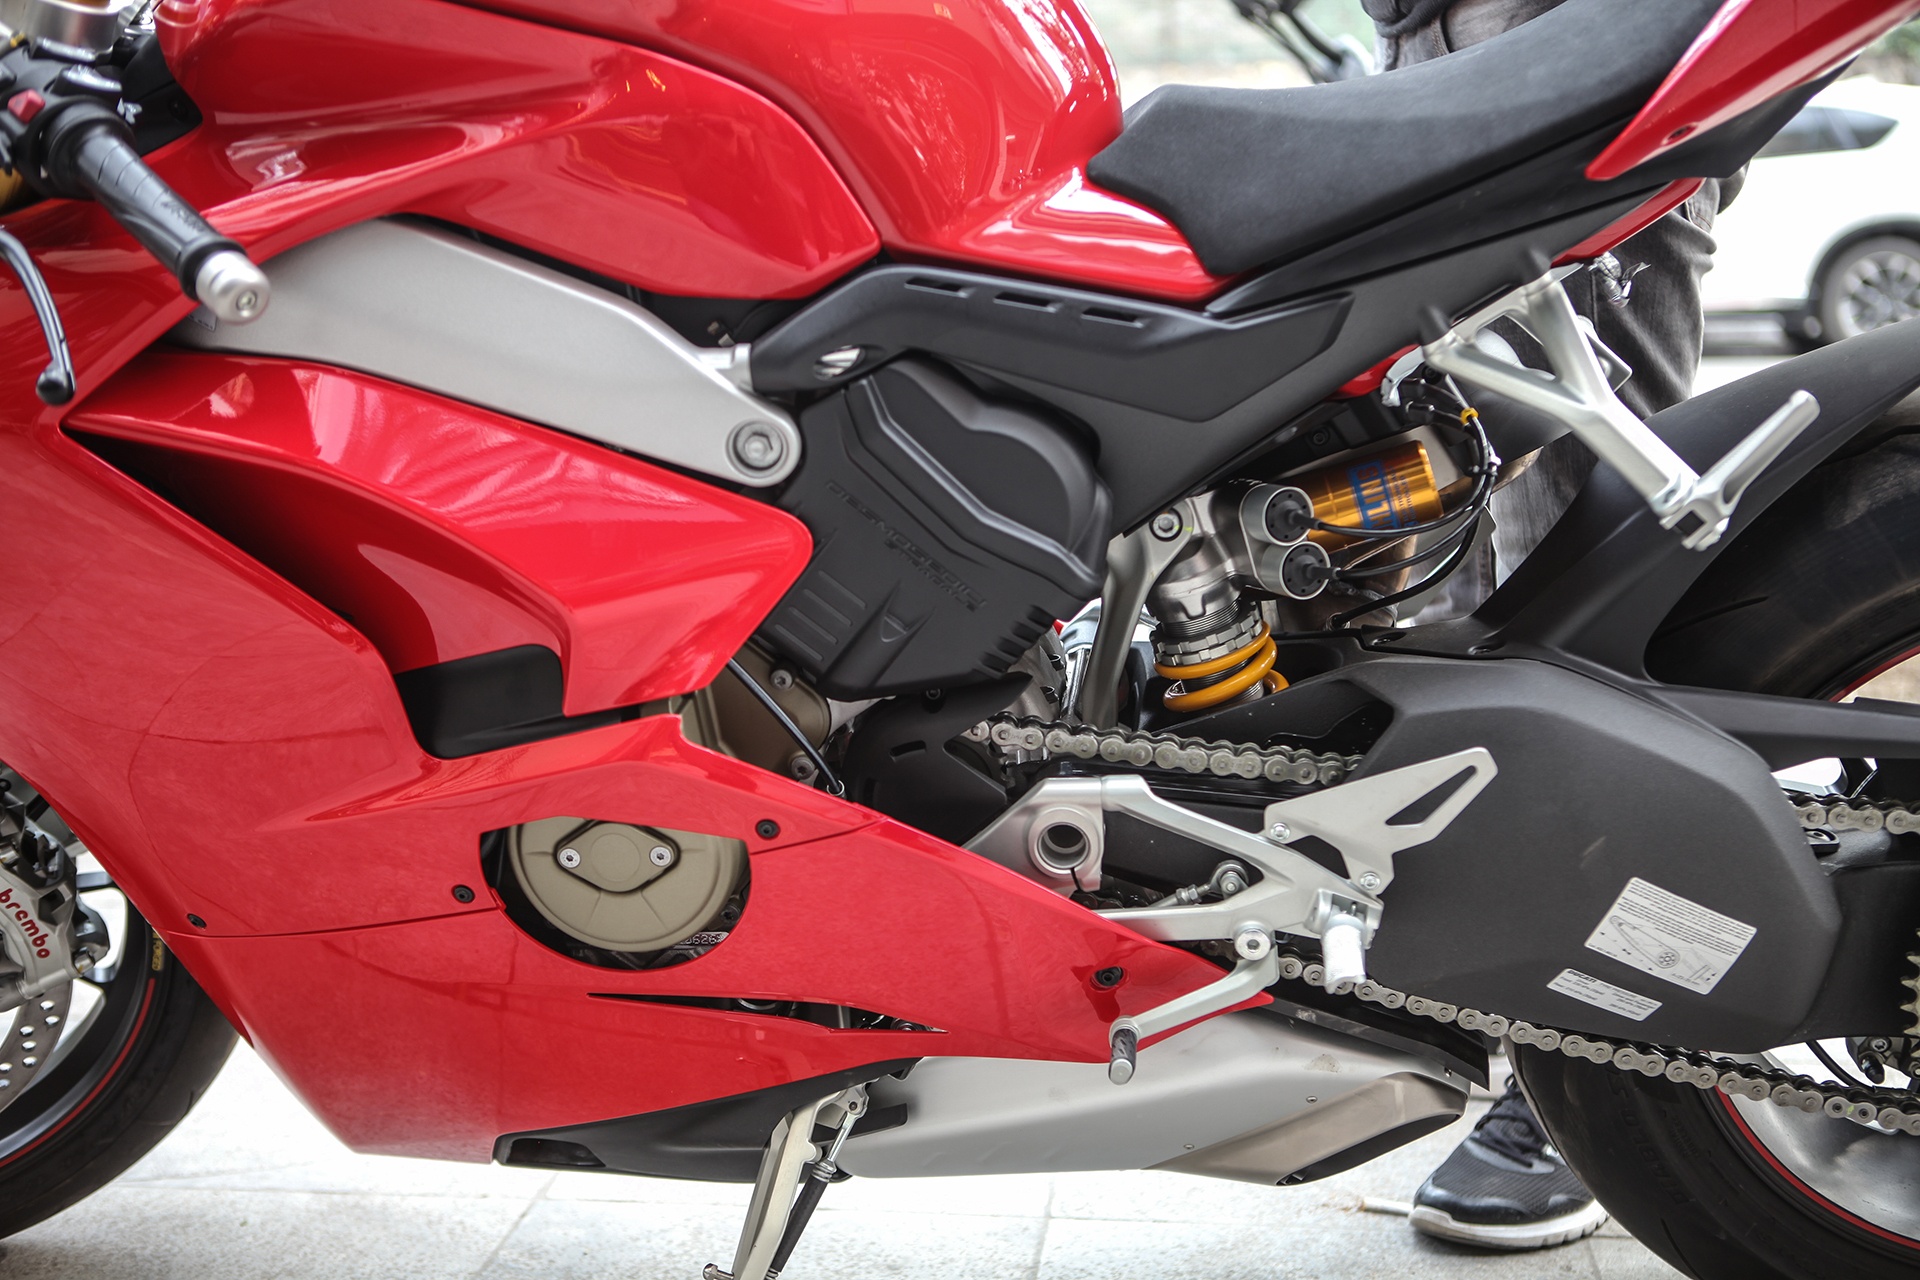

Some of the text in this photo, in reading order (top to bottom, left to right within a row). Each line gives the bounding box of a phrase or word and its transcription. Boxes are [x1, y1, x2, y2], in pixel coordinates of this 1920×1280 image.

[826, 480, 987, 606] DESMOSEDICI
[0, 888, 50, 959] brembo
[1567, 969, 1597, 983] DUCATI
